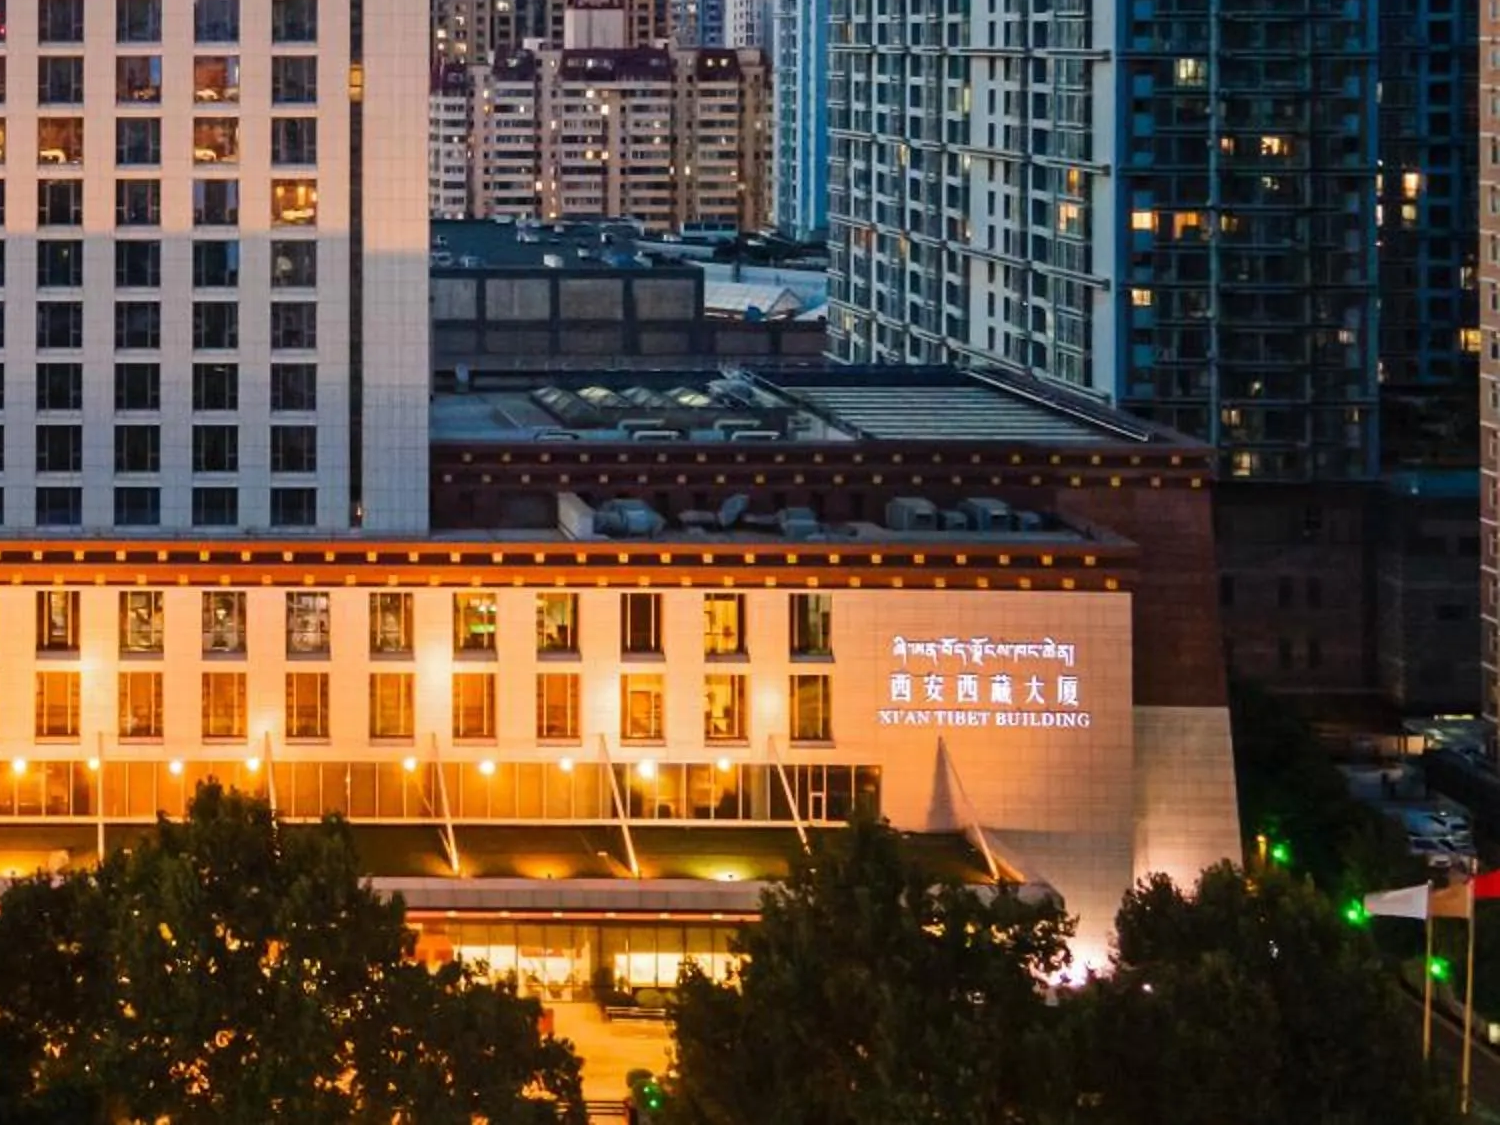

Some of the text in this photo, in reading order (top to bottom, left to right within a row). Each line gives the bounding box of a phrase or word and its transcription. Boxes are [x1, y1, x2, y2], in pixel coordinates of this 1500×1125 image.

[890, 674, 1079, 706] 西安西藏大厦
[934, 711, 991, 726] TIBET
[995, 712, 1091, 728] BUILDING
